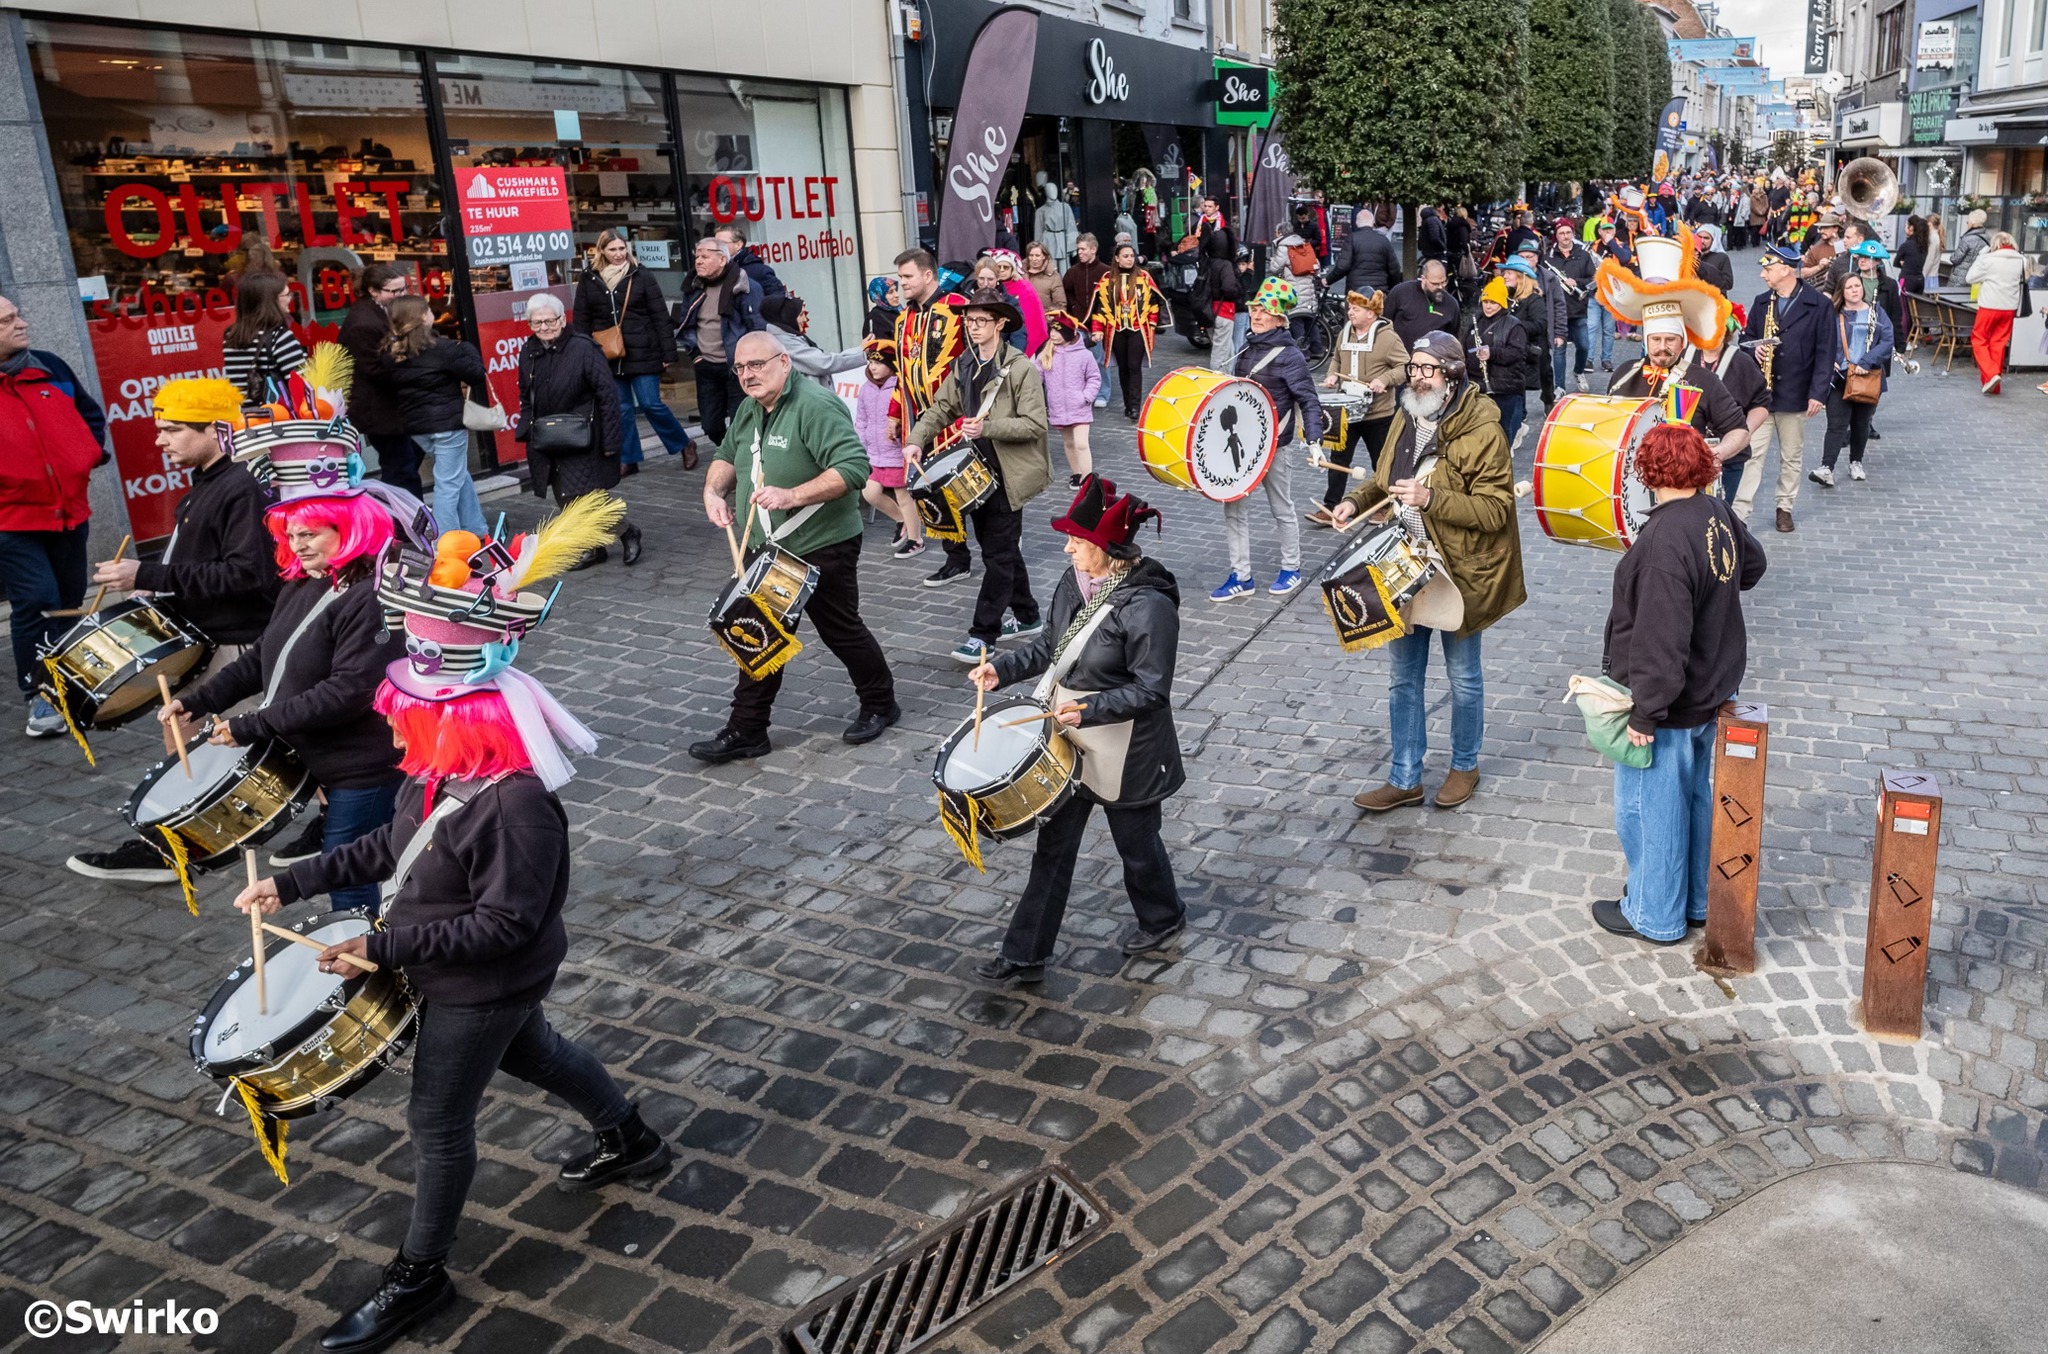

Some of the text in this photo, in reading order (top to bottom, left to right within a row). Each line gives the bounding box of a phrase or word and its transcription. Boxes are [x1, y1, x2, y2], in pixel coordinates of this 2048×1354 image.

[1088, 37, 1129, 104] She
[1222, 75, 1261, 104] She
[1261, 142, 1290, 173] Sh
[496, 176, 557, 187] CUSHMAN &
[949, 126, 1008, 222] She
[498, 187, 559, 198] WAKEFIELD
[708, 175, 839, 225] OUTLET
[104, 180, 410, 259] OUTLET
[467, 206, 519, 219] TE HUUR
[472, 232, 569, 257] 02 514 40 00
[641, 245, 661, 253] VRIJE
[797, 229, 854, 261] Buffalo
[474, 253, 543, 266] cushmanwakefield.be
[147, 324, 195, 345] OUTLET
[151, 345, 161, 356] BY
